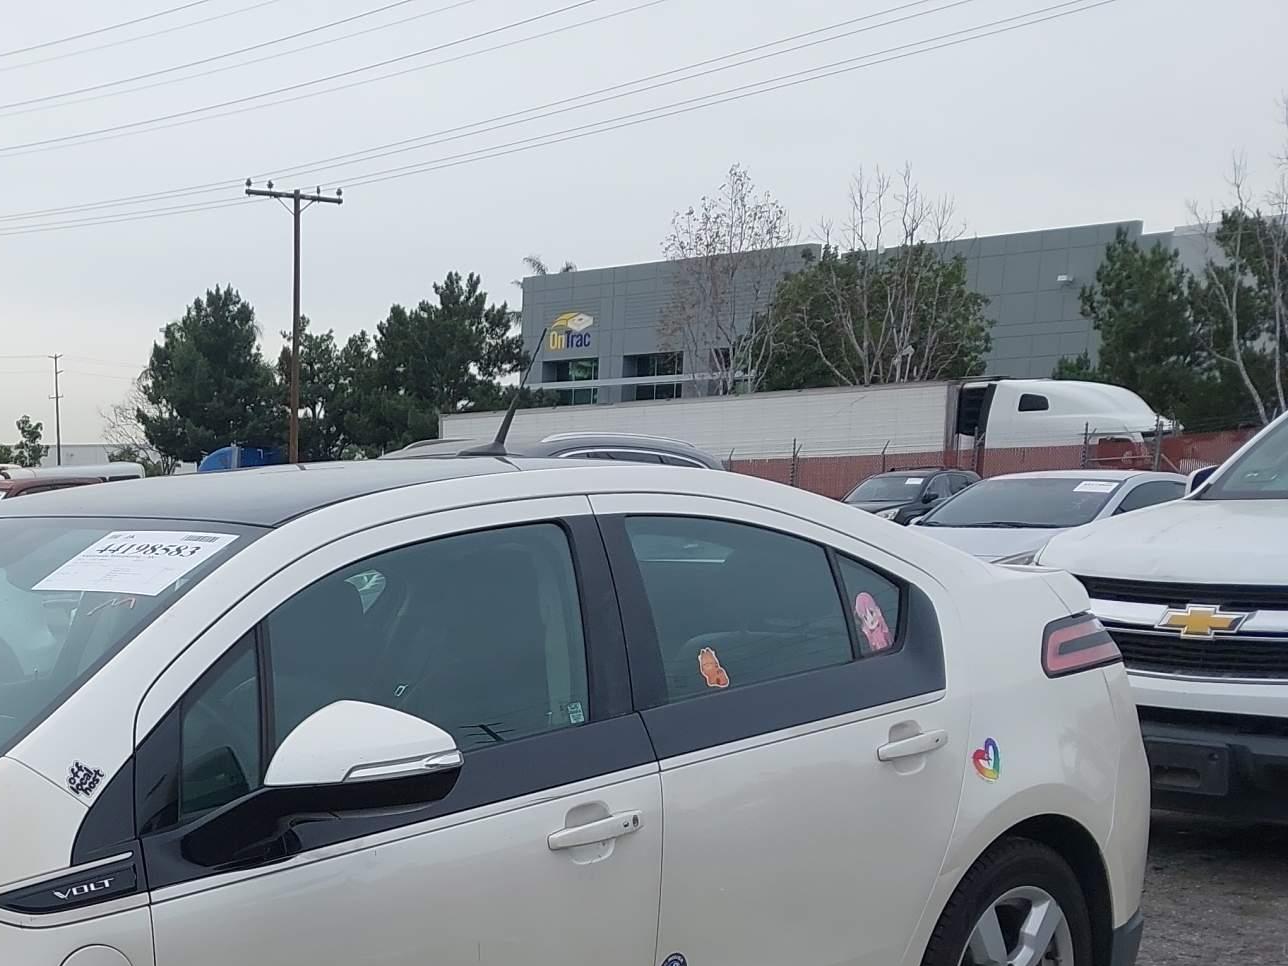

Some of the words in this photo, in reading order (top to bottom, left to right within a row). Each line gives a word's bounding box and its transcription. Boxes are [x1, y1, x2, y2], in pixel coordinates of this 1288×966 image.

[549, 330, 591, 350] OnTrac
[95, 543, 202, 558] 44198583
[69, 766, 94, 795] local
[81, 769, 105, 796] host
[52, 878, 115, 900] VOLT
